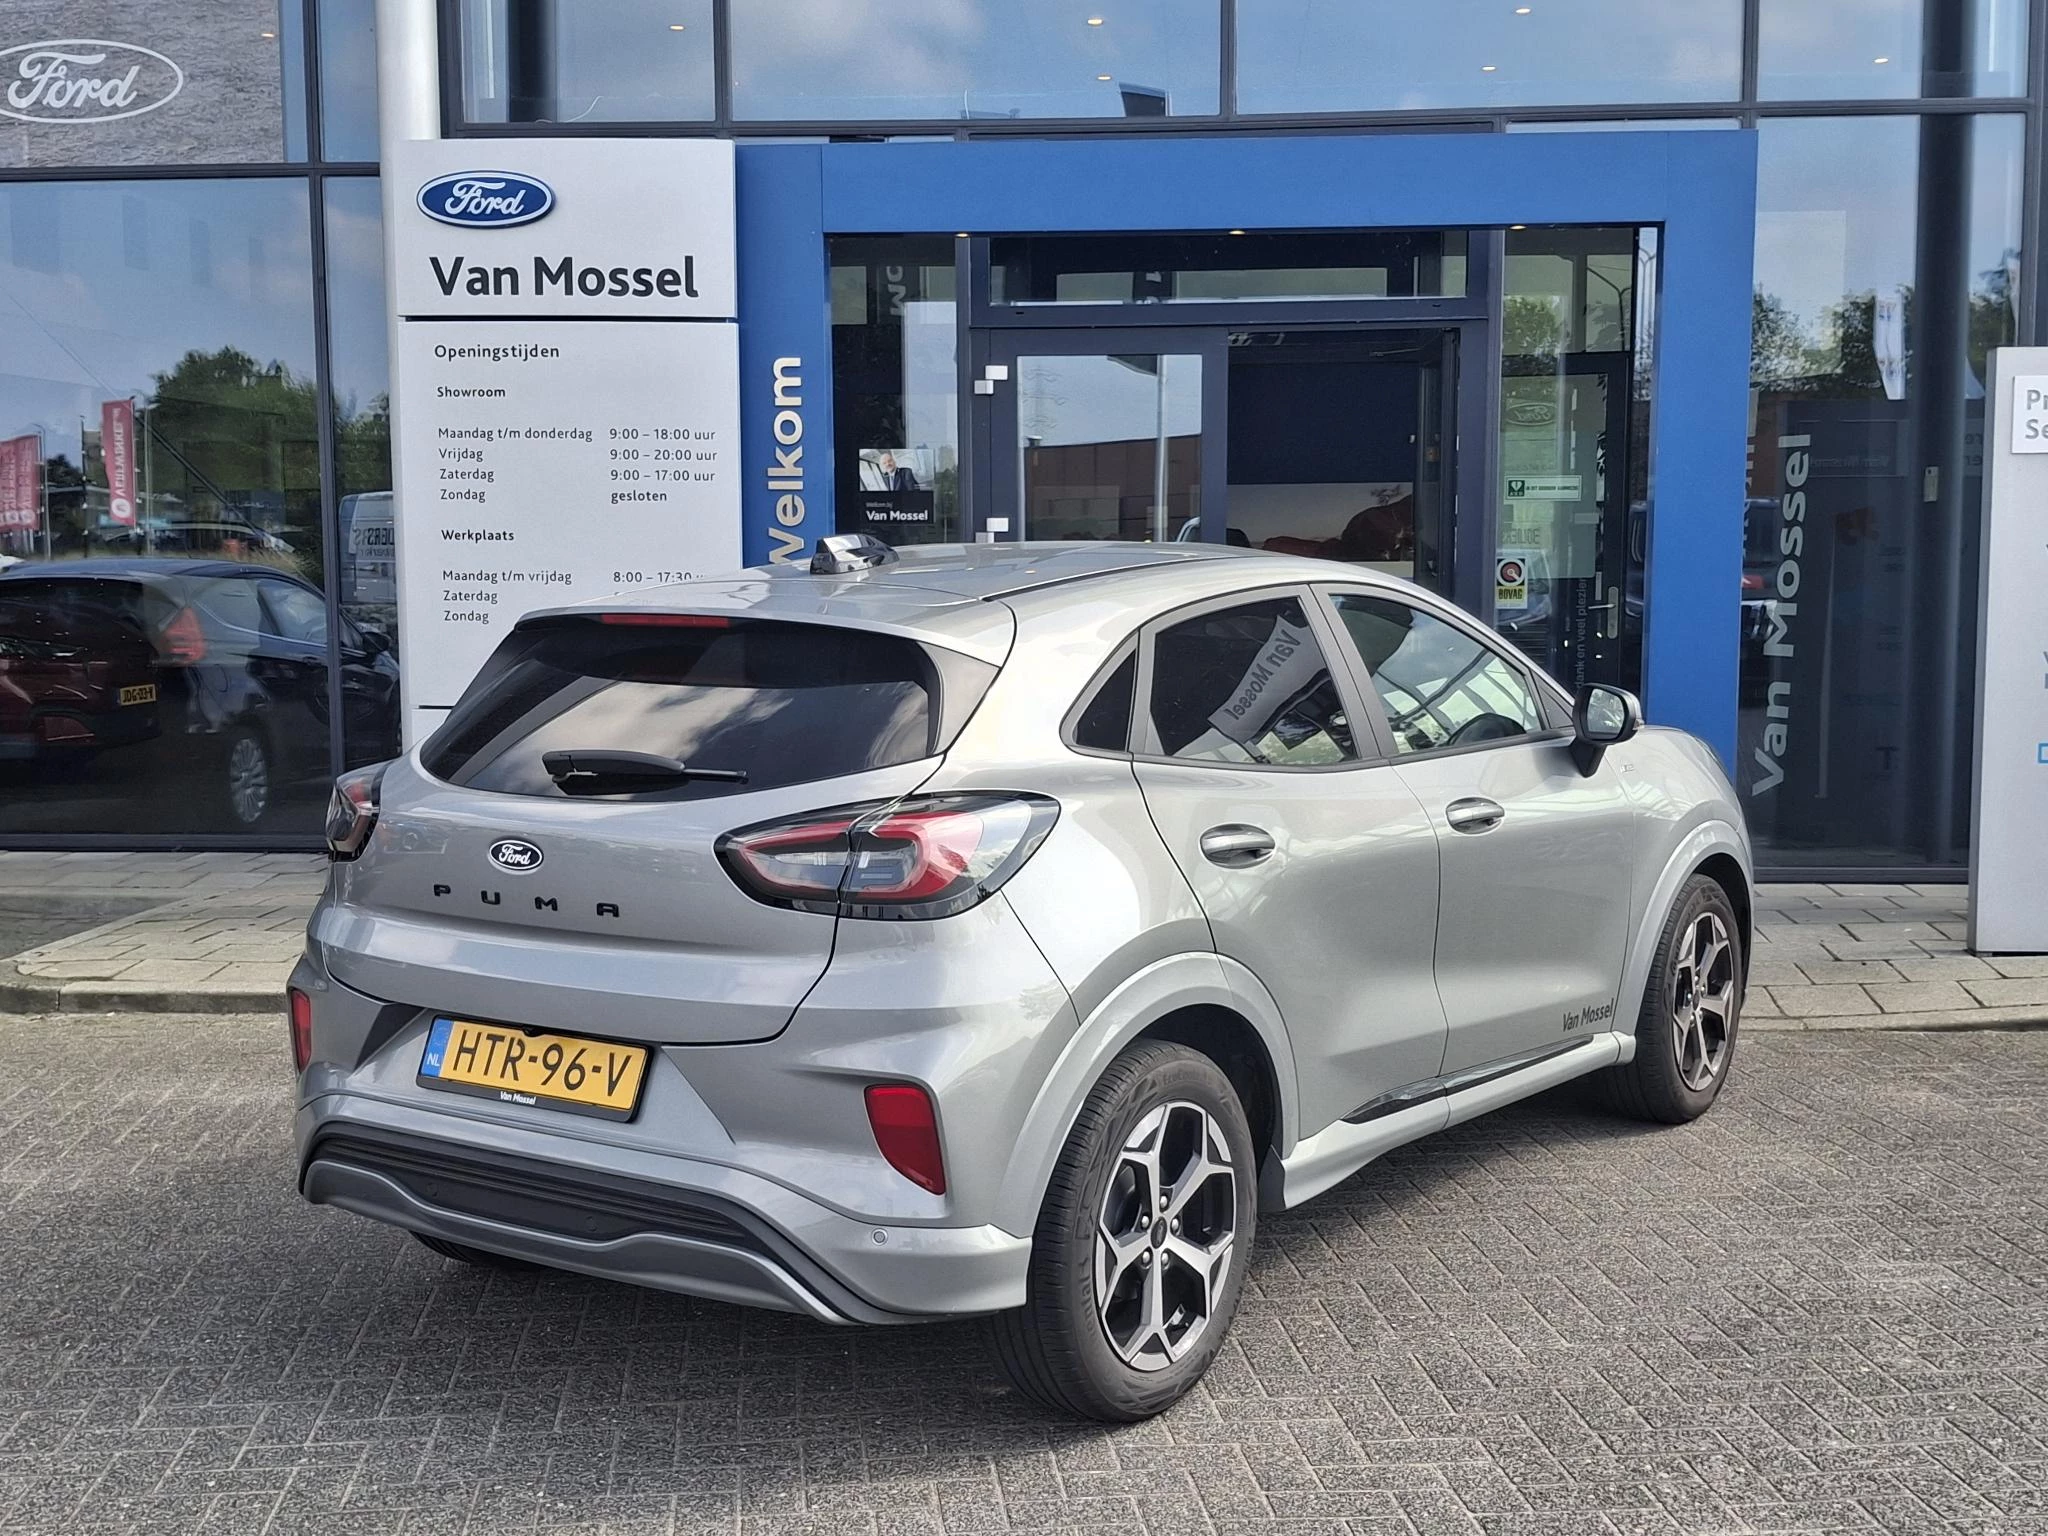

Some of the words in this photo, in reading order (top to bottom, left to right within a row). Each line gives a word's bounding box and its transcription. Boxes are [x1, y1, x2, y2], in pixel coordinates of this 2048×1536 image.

[7, 52, 141, 109] Ford
[444, 180, 526, 215] Ford
[429, 256, 520, 296] Van
[533, 255, 699, 298] Mossel
[434, 344, 560, 362] Openingstijden
[437, 386, 506, 398] Showroom
[438, 427, 494, 442] Maandag
[497, 427, 521, 440] t/m
[524, 427, 593, 443] donderdag
[609, 428, 639, 440] 9:00
[653, 428, 690, 440] 18:00
[694, 430, 716, 441] uur
[438, 447, 484, 463] Vrijdag
[609, 448, 640, 461] 9:00
[654, 449, 692, 461] 20:00
[696, 451, 718, 461] uur
[767, 357, 805, 564] Welkom
[439, 467, 495, 483] Zaterdag
[610, 469, 640, 481] 9:00
[654, 469, 690, 482] 17:00
[694, 472, 716, 482] uur
[440, 488, 486, 504] Zondag
[610, 489, 667, 505] gesloten
[866, 510, 887, 521] Van
[889, 509, 928, 521] Mossel
[441, 528, 515, 544] Werkplaats
[1763, 434, 1811, 657] Mossel
[442, 569, 498, 585] Maandag
[501, 570, 525, 582] t/m
[528, 570, 572, 586] vrijdag
[613, 571, 643, 583] 8:00
[443, 589, 498, 605] Zaterdag
[1498, 588, 1523, 600] BOVAG
[443, 609, 490, 625] Zondag
[1752, 681, 1791, 796] Van
[498, 843, 532, 866] Ford
[433, 883, 620, 918] PUMA
[1563, 1011, 1580, 1033] Van
[1581, 997, 1615, 1026] Mossel
[427, 1051, 441, 1067] NL
[452, 1028, 633, 1097] HTR-96-V
[500, 1090, 512, 1101] Van
[512, 1093, 537, 1105] Mossel
